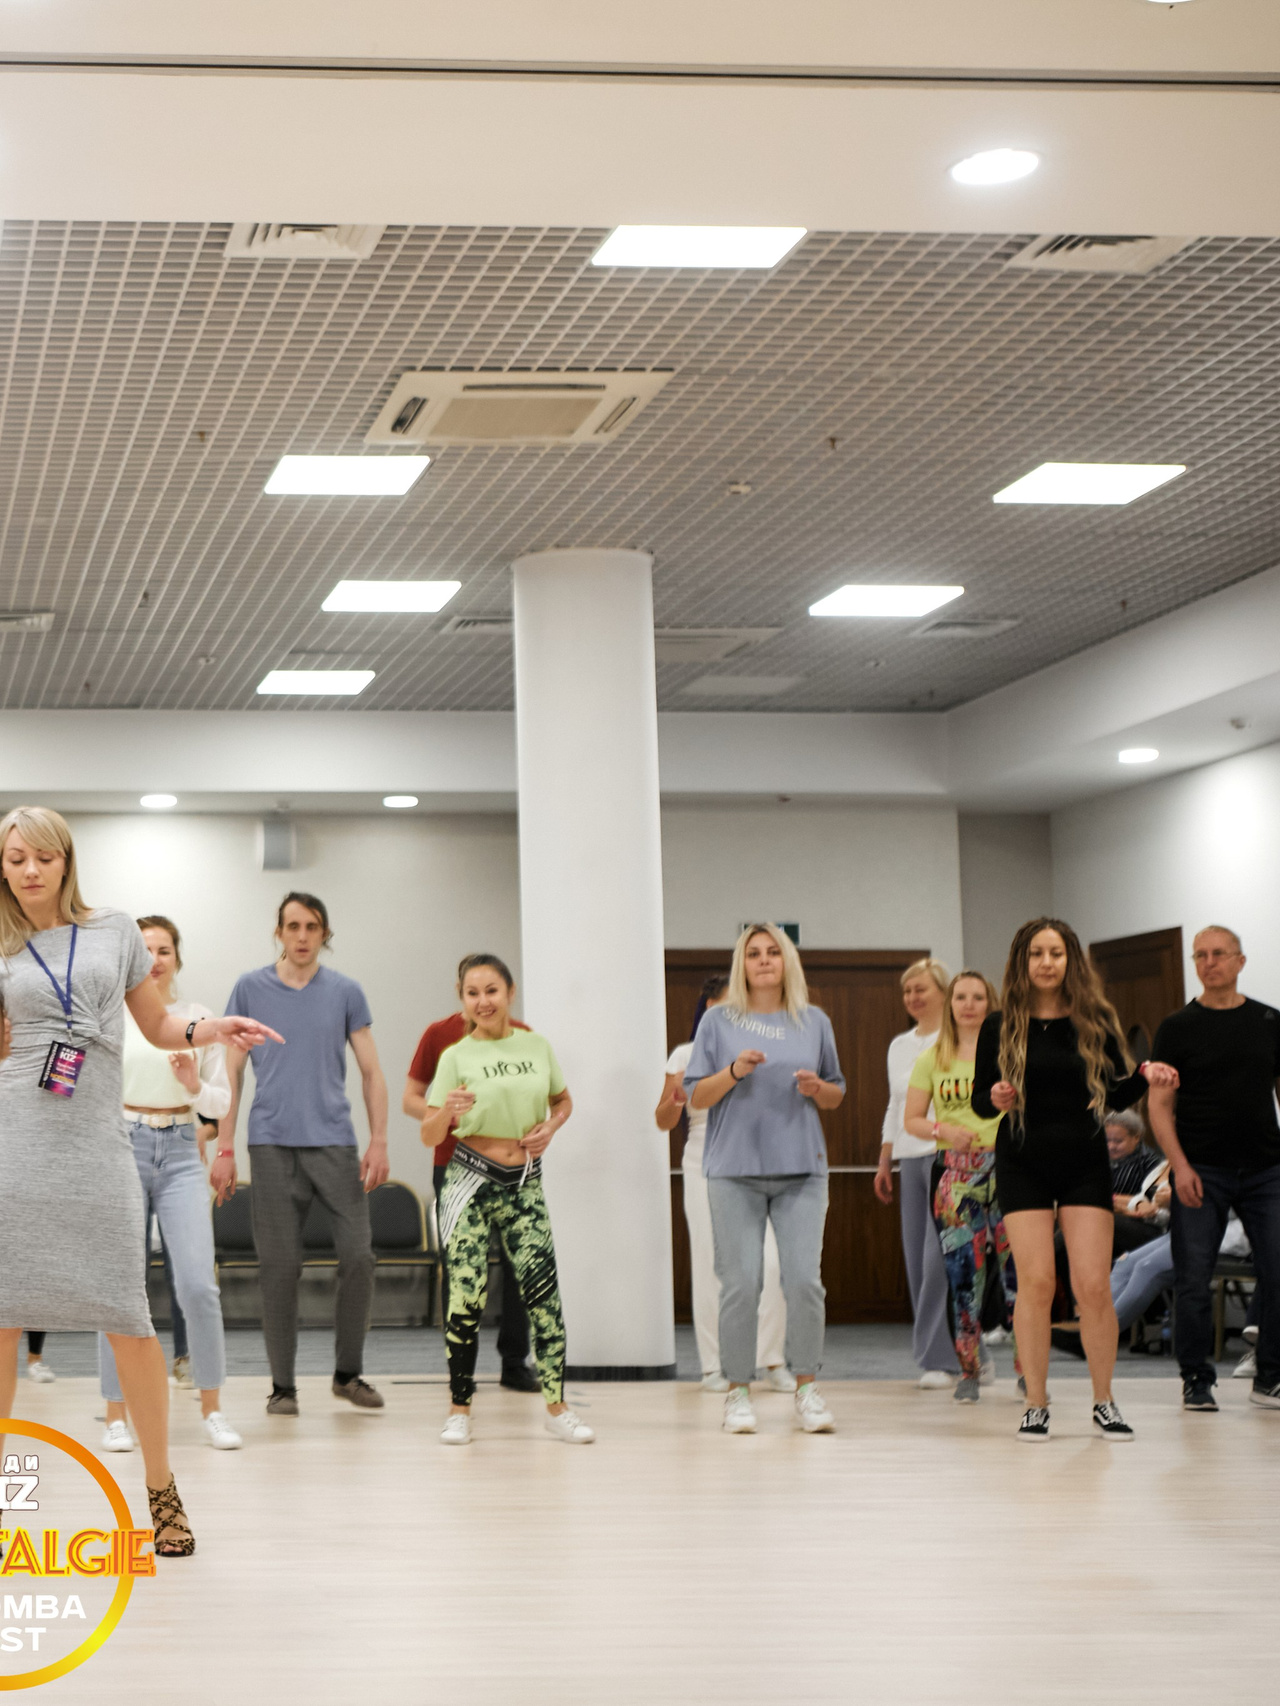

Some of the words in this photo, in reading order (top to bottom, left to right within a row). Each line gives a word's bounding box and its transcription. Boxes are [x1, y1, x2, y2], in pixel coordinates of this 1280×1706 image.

[722, 1007, 786, 1040] SUNRISE
[483, 1060, 538, 1079] DIOR
[940, 1078, 974, 1102] GU
